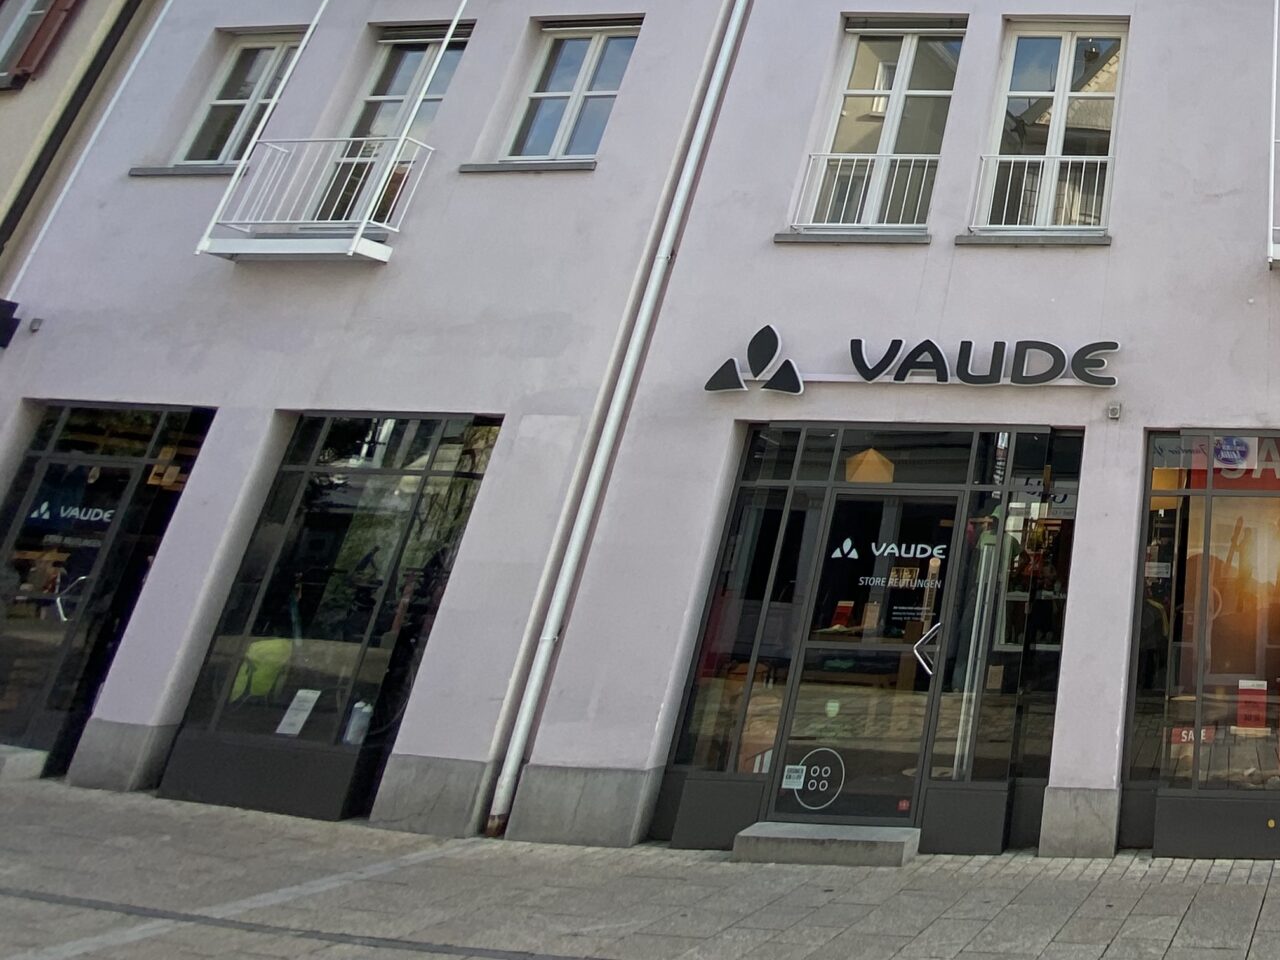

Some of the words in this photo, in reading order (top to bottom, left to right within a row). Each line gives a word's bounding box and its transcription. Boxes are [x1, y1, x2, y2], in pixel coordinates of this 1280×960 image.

[850, 338, 1120, 387] VAUDE
[60, 505, 115, 522] VAUDE
[871, 542, 947, 558] VAUDE
[858, 576, 886, 587] STORE
[887, 578, 942, 589] REUTLINGEN
[1181, 728, 1207, 742] SAE
